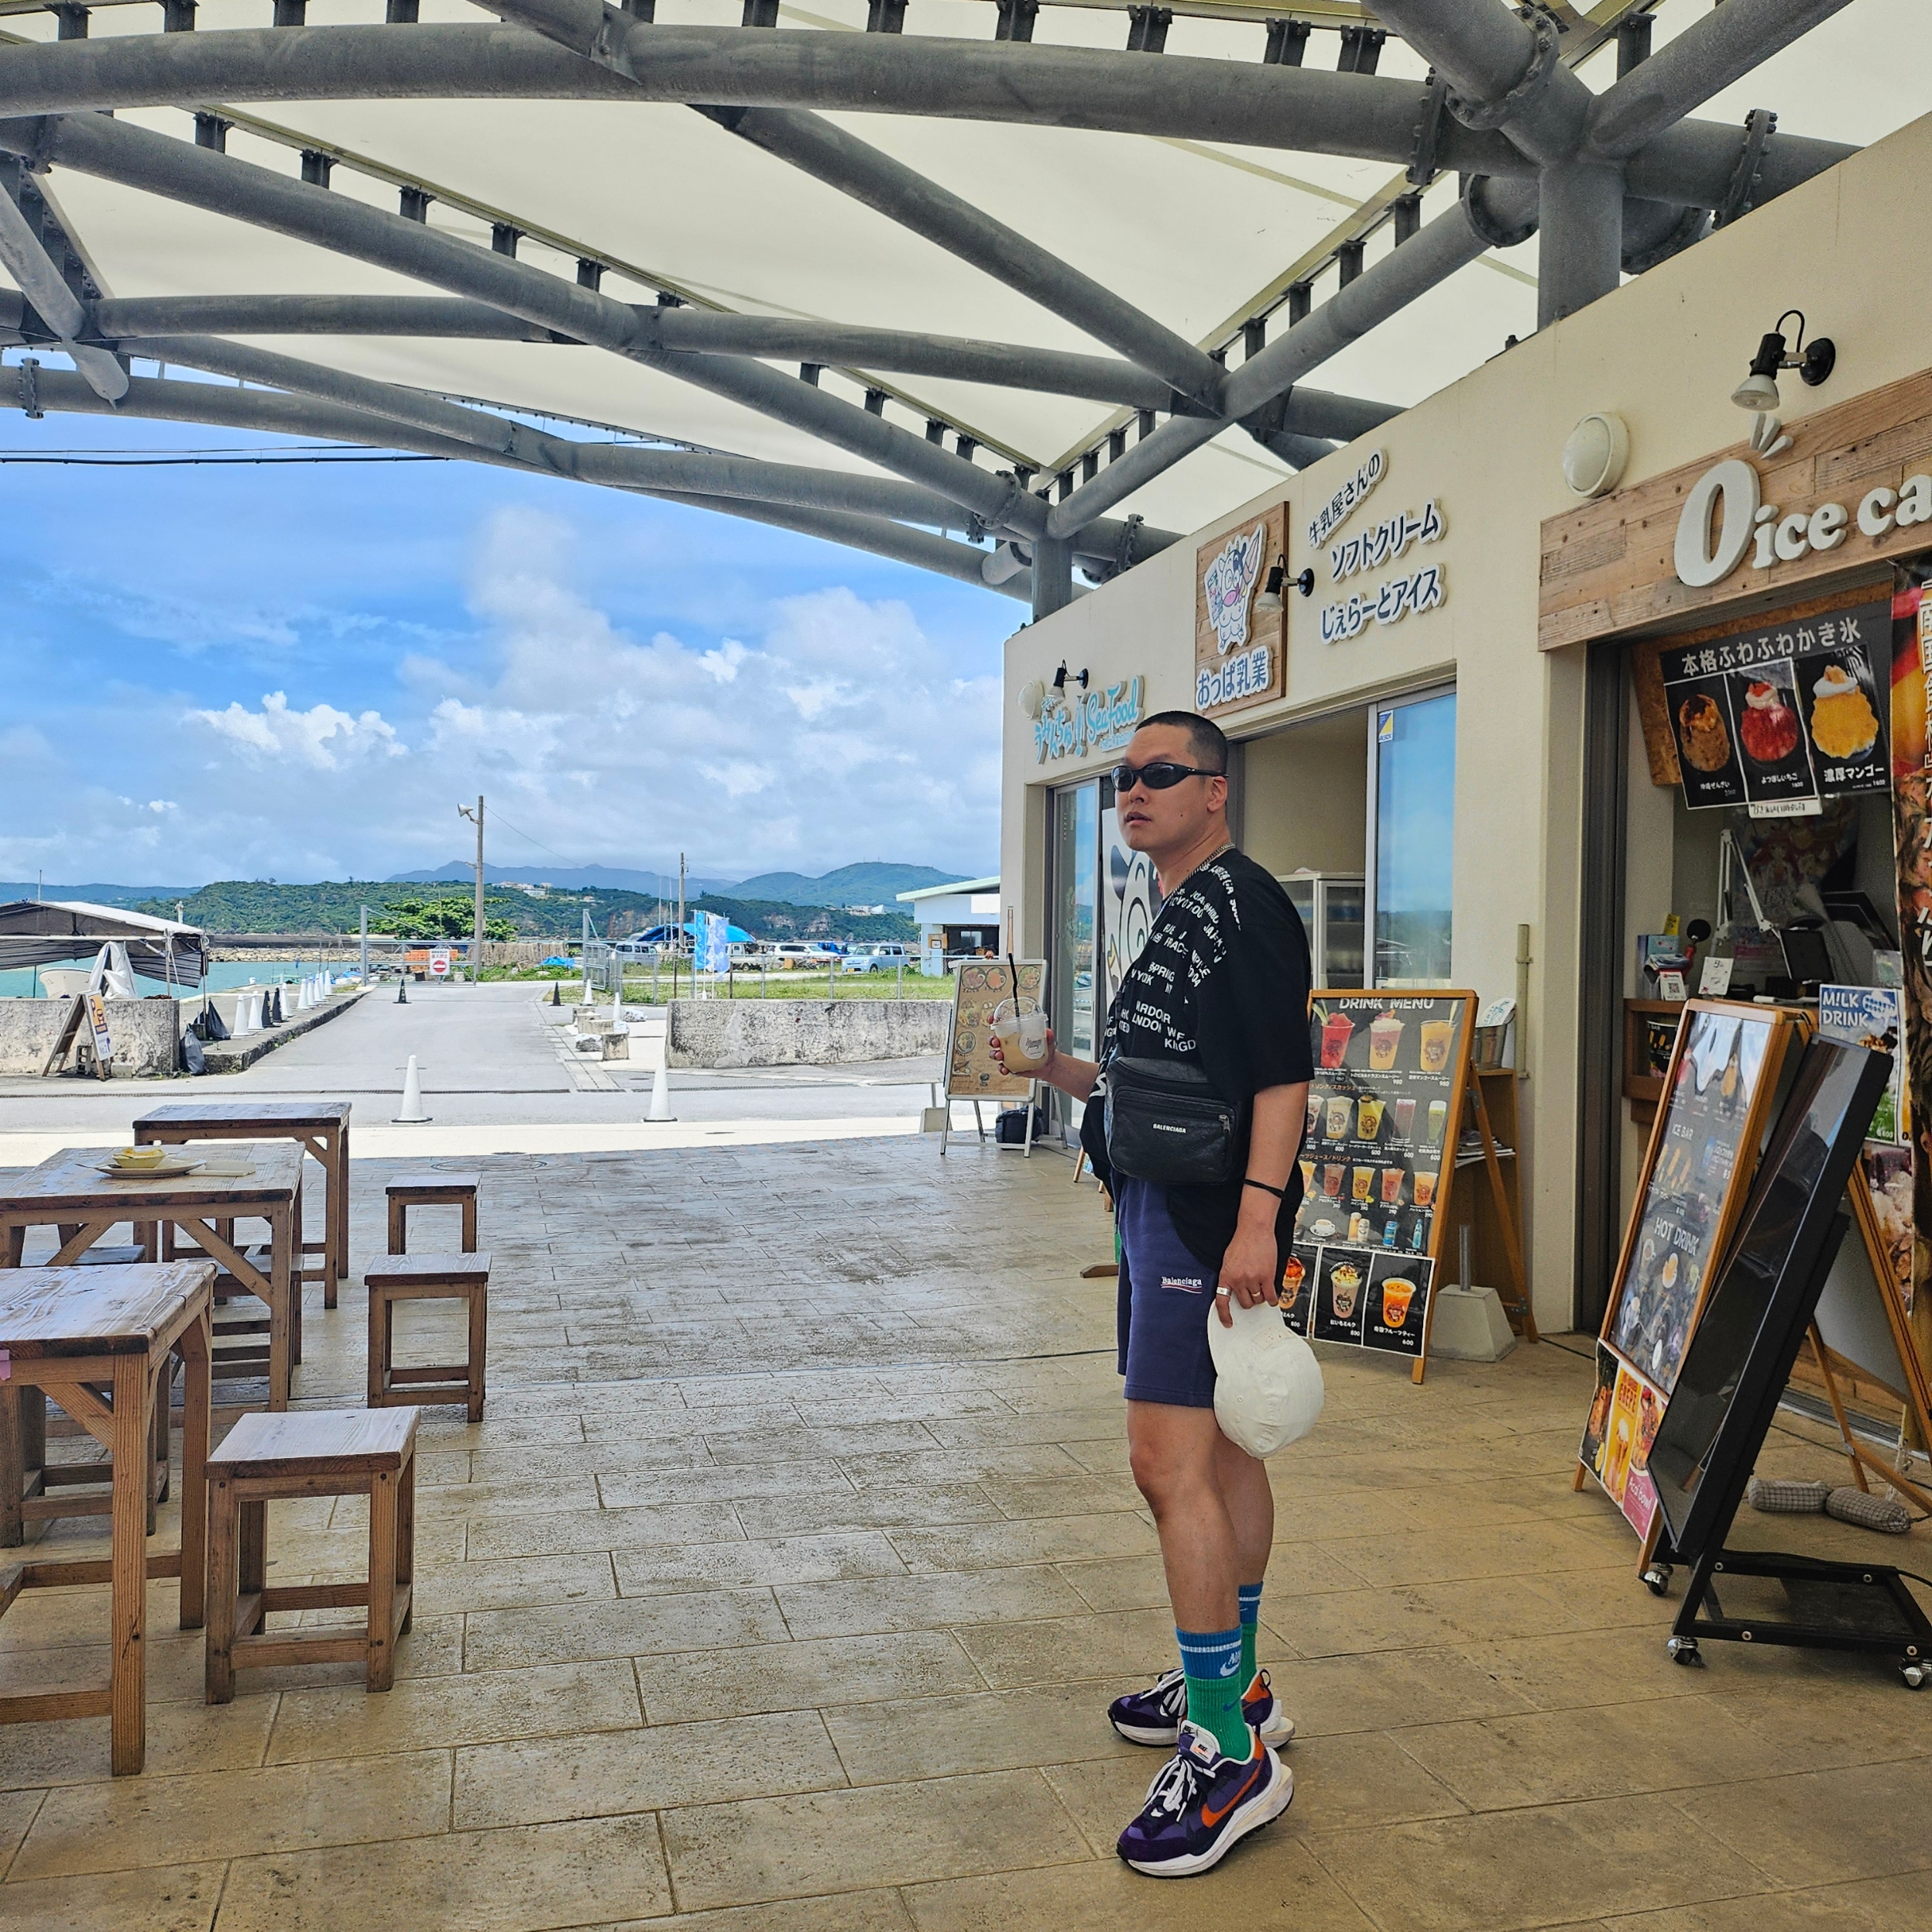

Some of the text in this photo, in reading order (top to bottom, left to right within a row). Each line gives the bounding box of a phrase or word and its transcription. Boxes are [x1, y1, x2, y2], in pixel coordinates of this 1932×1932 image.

[1309, 452, 1381, 544] 牛乳屋さんの
[1331, 503, 1439, 579] ソフトクリーム
[1321, 568, 1439, 642] じぇらーとアイス
[1681, 617, 1862, 677] 本格ふわふわかき氷
[1197, 649, 1268, 706] おっぱ乳業
[1339, 997, 1434, 1010] DRINK MENU
[1822, 1010, 1869, 1028] DRINK
[1152, 1123, 1187, 1134] BALENCIAGA
[1681, 1127, 1694, 1141] BAR
[1654, 1217, 1700, 1256] HOT DRINK
[1161, 1276, 1203, 1286] Balenciaga
